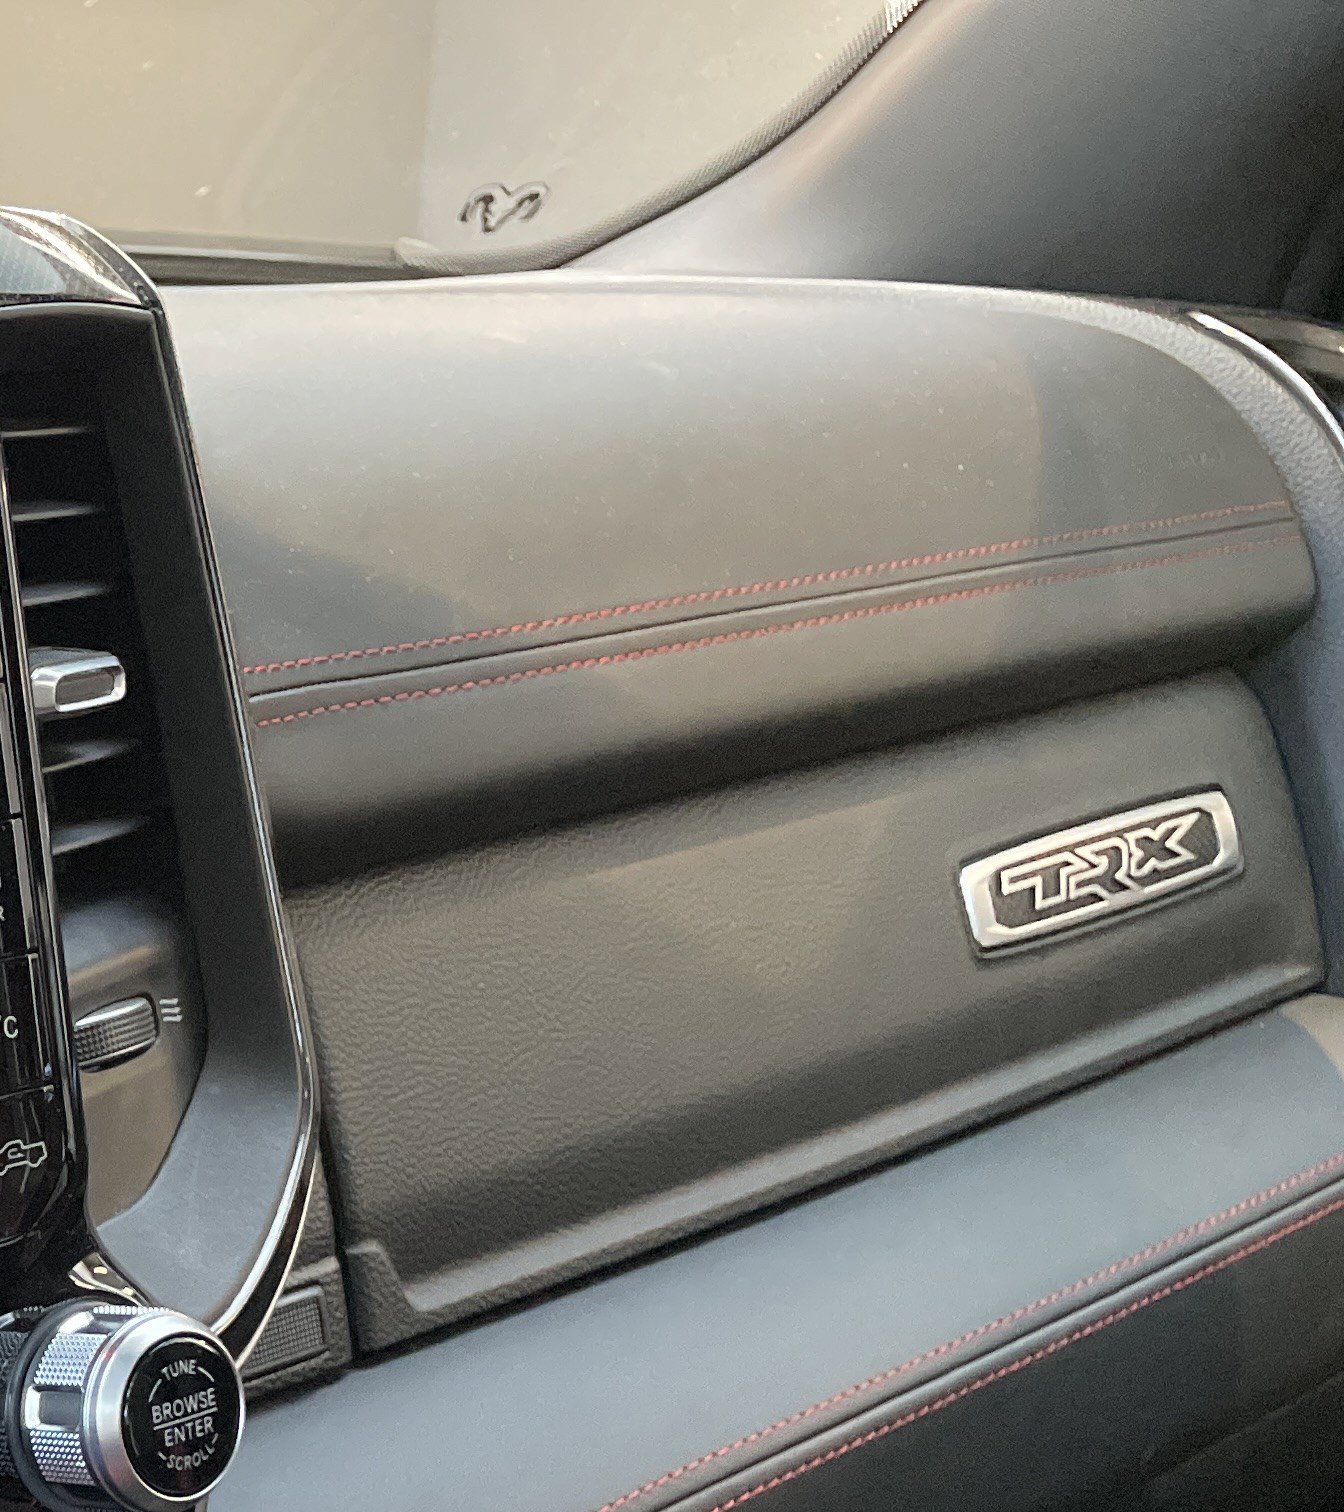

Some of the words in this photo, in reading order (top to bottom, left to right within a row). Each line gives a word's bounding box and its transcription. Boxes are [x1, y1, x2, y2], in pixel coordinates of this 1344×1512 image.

[1000, 811, 1201, 910] TRX
[162, 1360, 197, 1383] TUNE
[151, 1388, 216, 1424] BROWSE
[164, 1416, 213, 1447] ENTER
[166, 1446, 214, 1471] SCROLL
